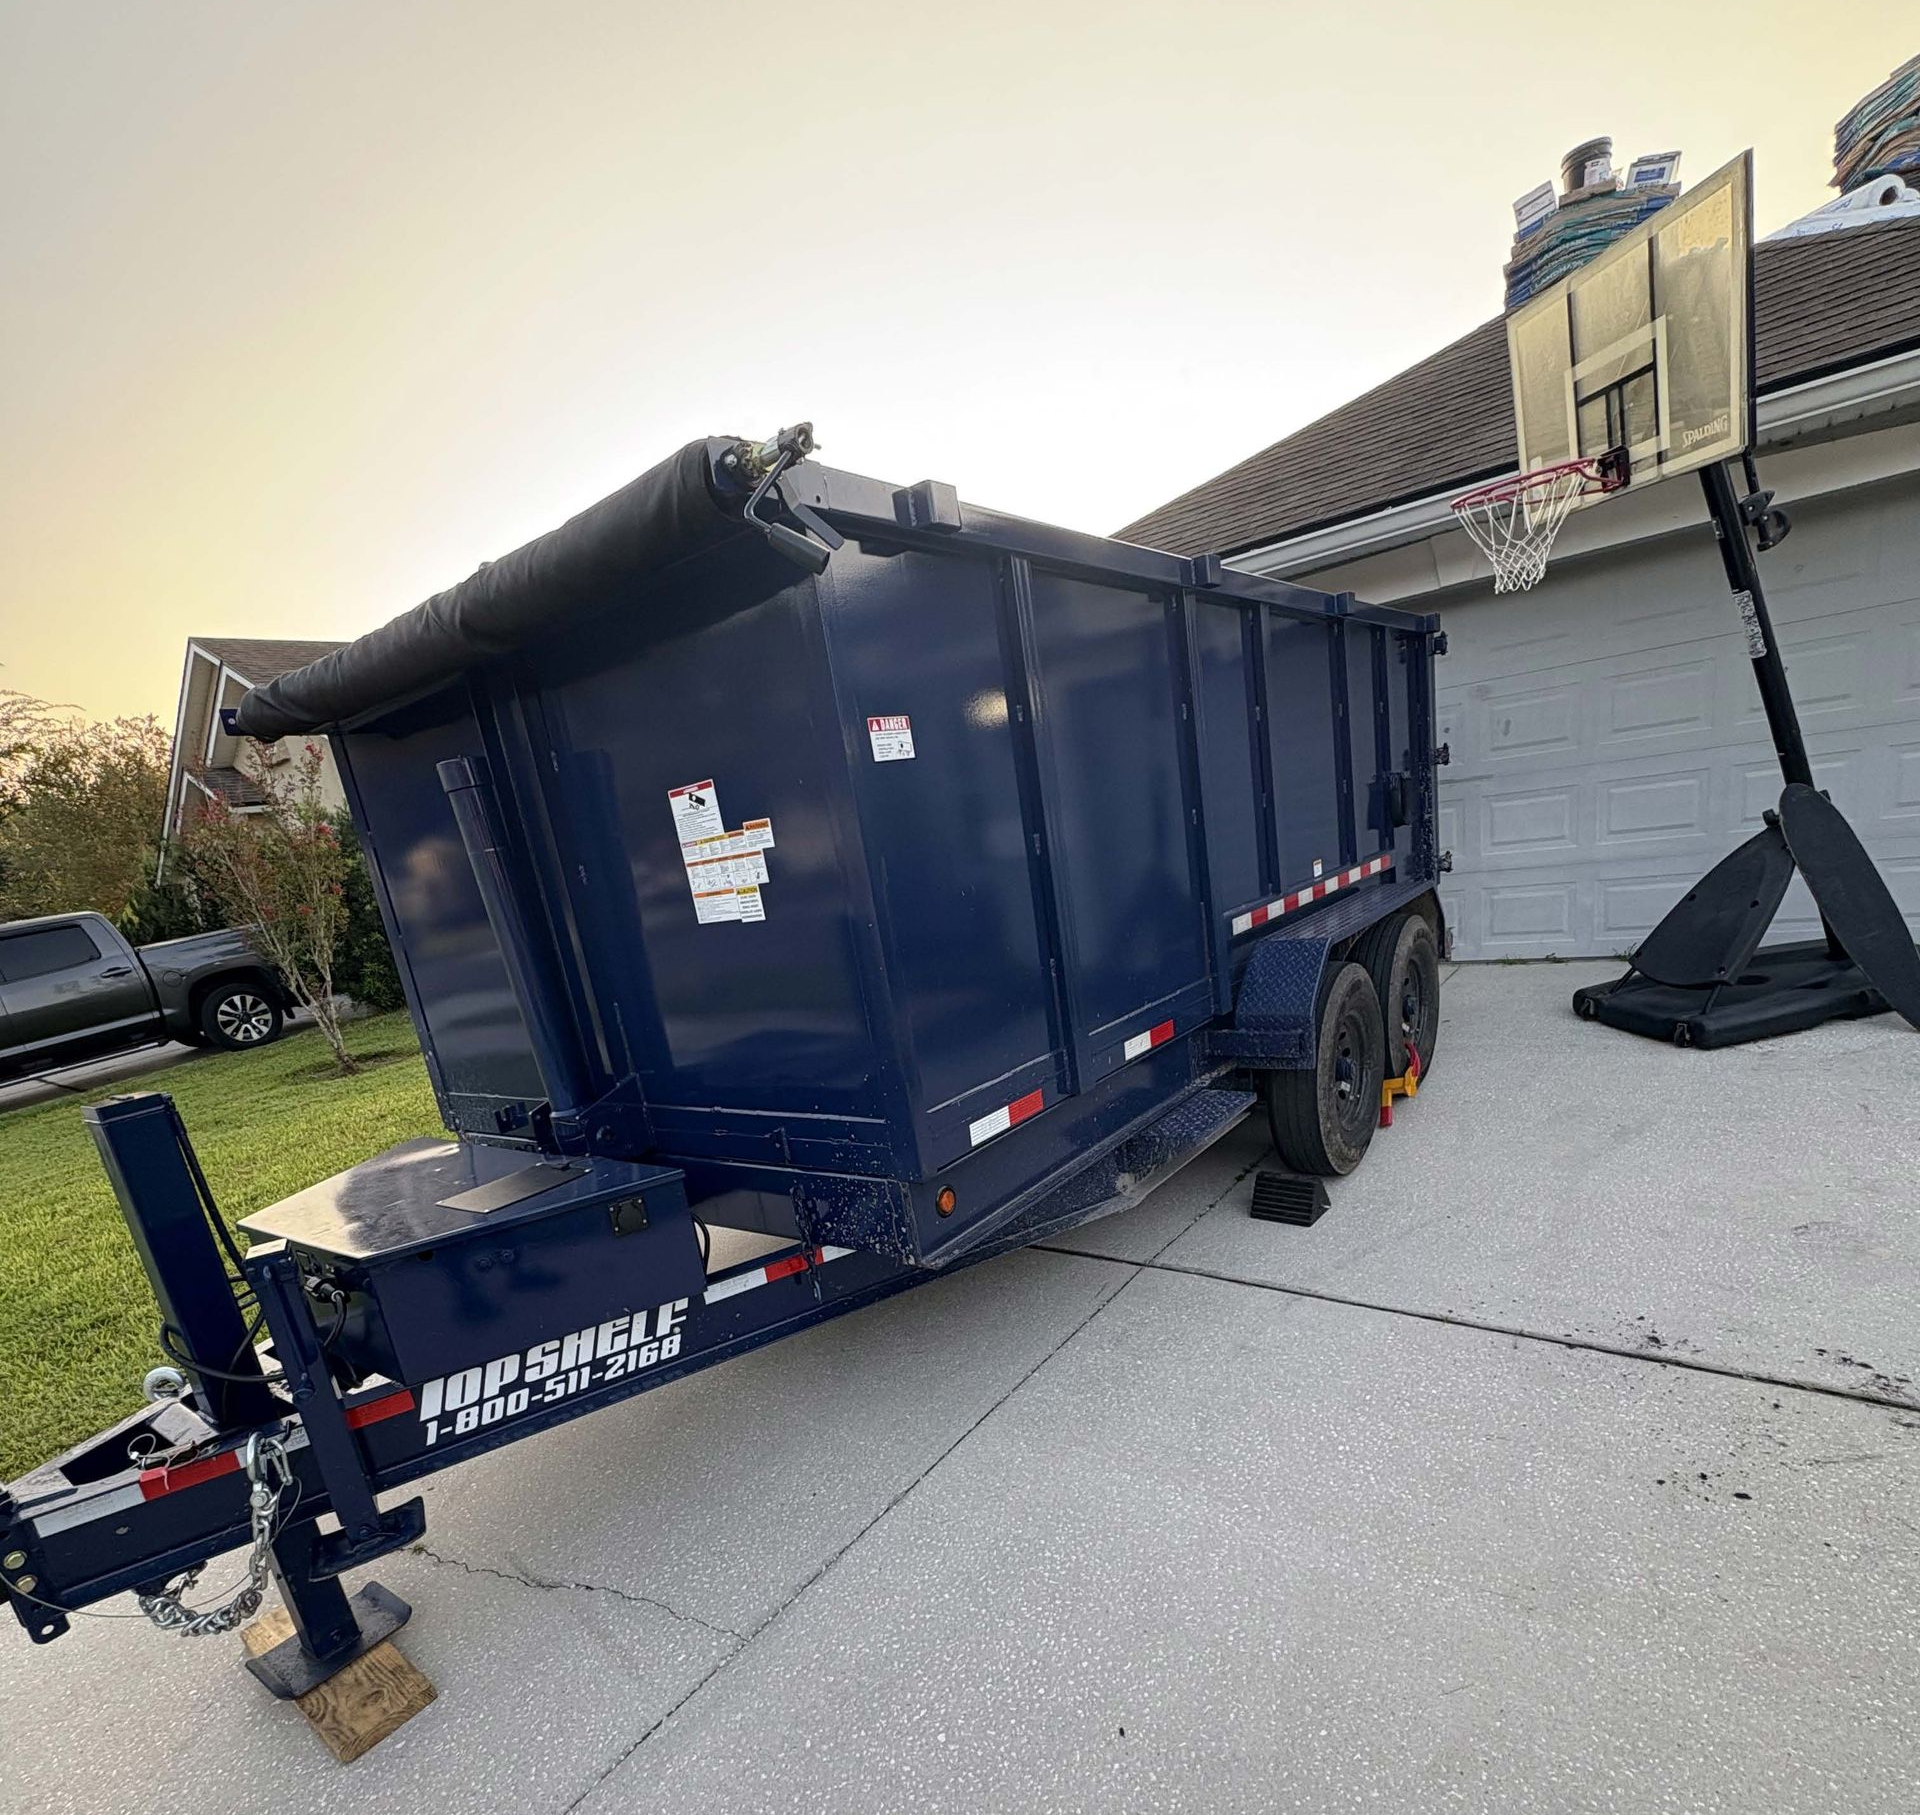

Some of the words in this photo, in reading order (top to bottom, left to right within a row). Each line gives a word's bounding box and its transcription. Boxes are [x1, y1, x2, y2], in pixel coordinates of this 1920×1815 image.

[1682, 414, 1728, 448] SPALDING
[880, 717, 908, 731] DANGER
[426, 1333, 682, 1446] 1-800-511-2168
